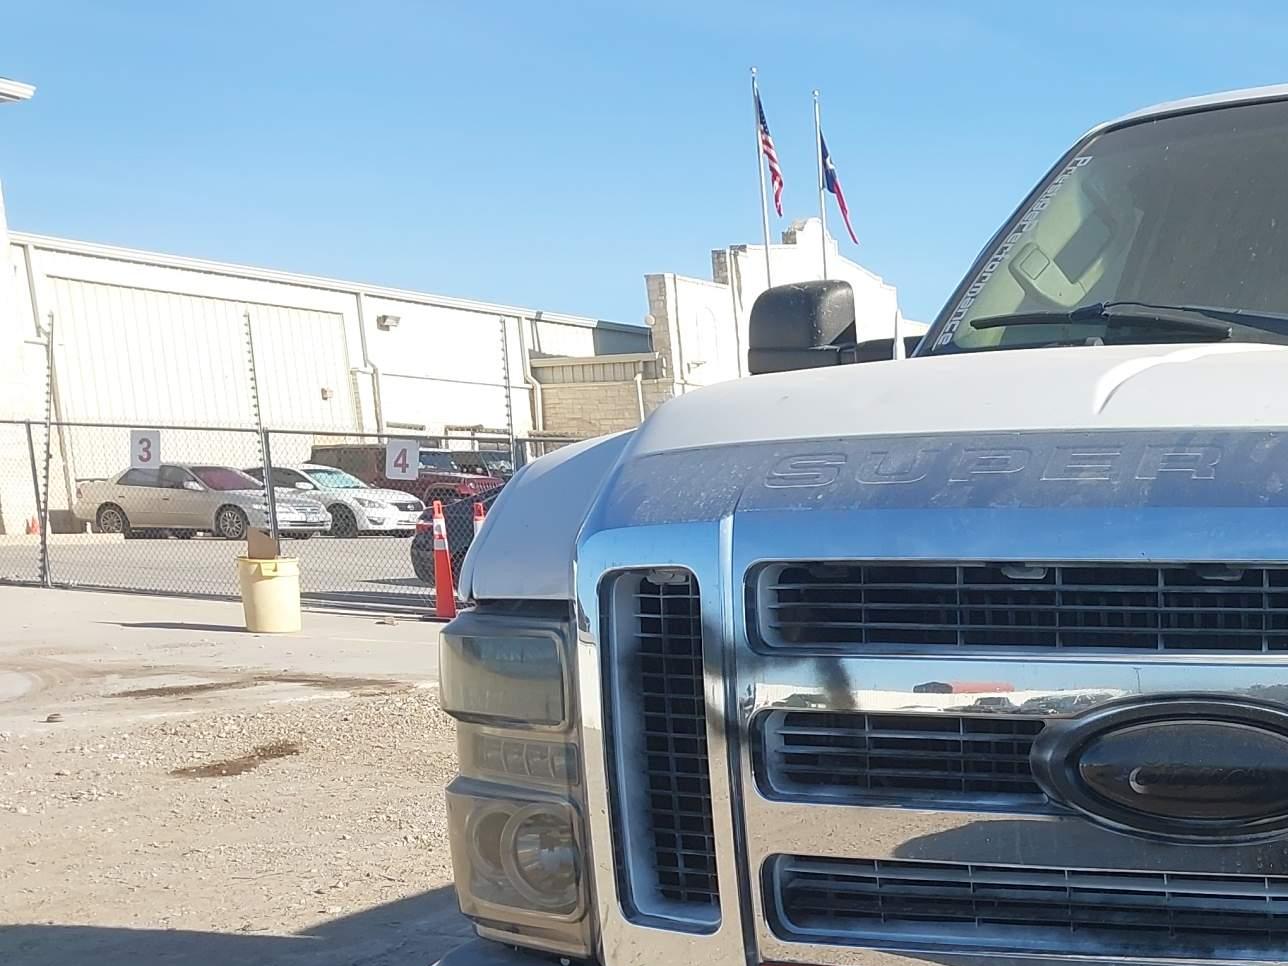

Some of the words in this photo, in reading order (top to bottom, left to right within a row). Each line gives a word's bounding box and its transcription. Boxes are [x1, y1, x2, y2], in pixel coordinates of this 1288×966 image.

[138, 438, 152, 463] 3
[393, 447, 410, 474] 4
[764, 444, 1226, 488] SUPER
